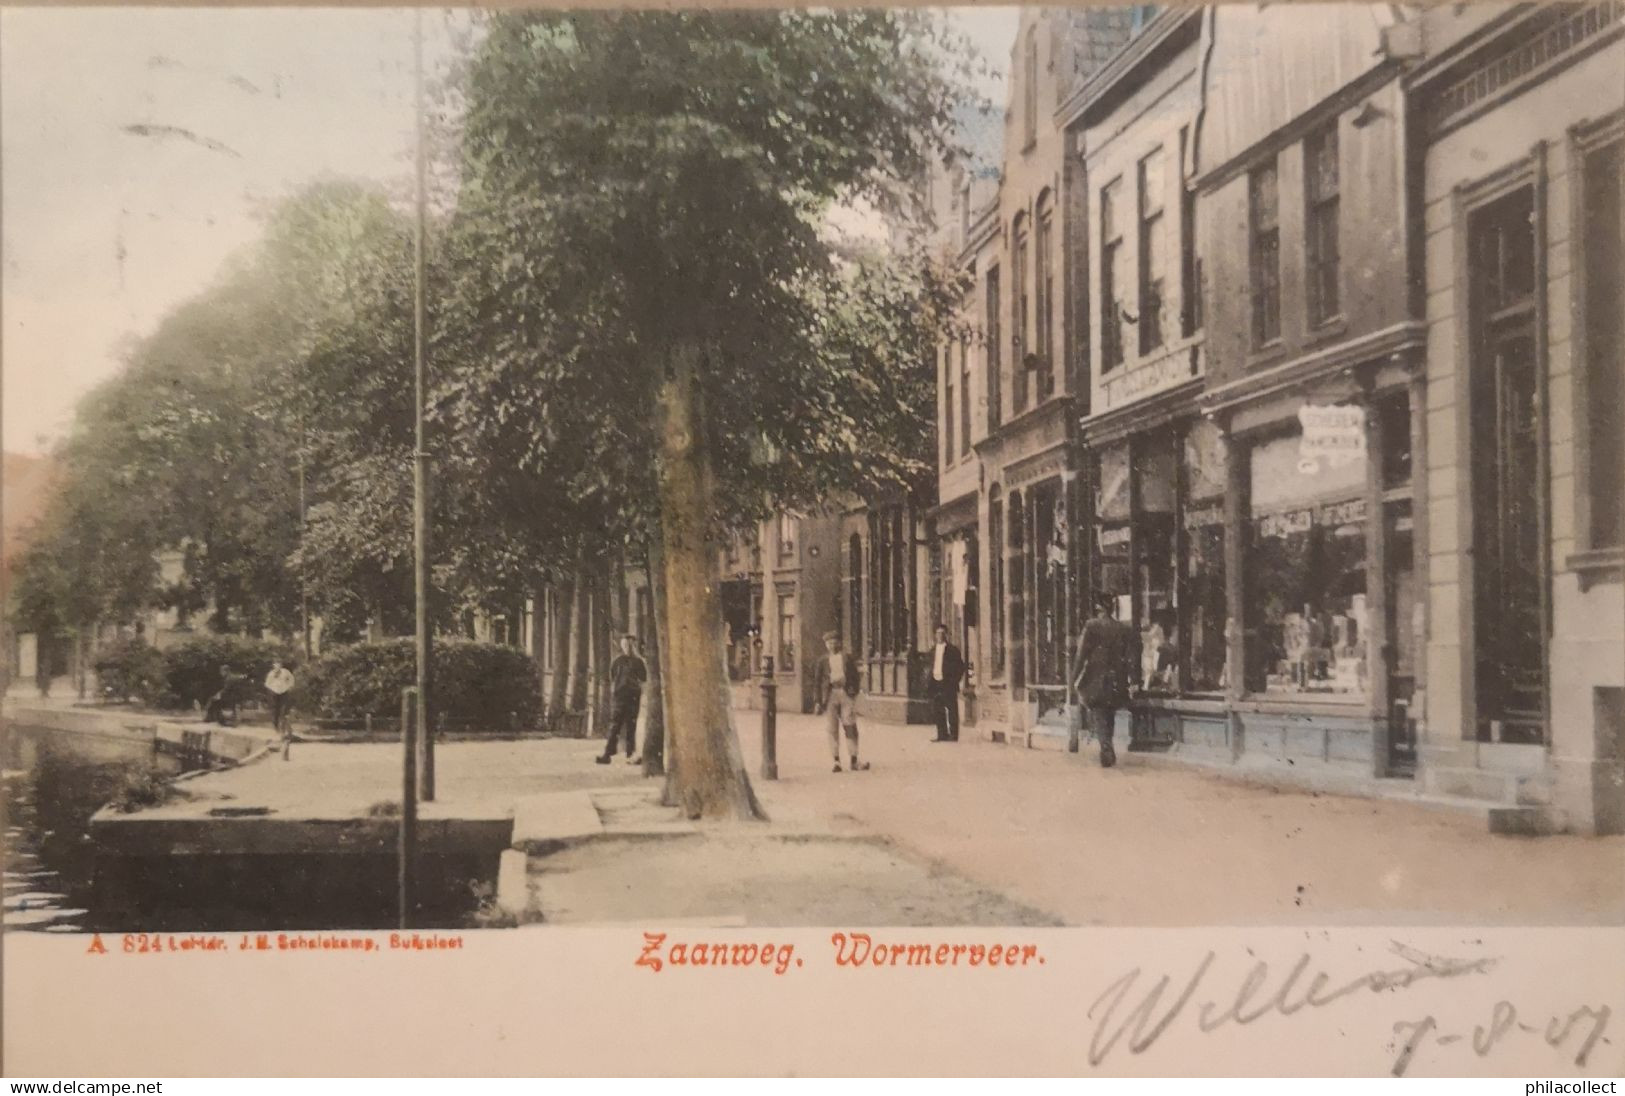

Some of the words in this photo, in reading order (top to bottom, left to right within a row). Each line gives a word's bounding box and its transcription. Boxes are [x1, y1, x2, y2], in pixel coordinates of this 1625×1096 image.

[86, 935, 107, 955] A
[122, 934, 163, 955] 824
[634, 931, 803, 975] Zaanweg.
[831, 931, 1045, 968] Wormerveer.
